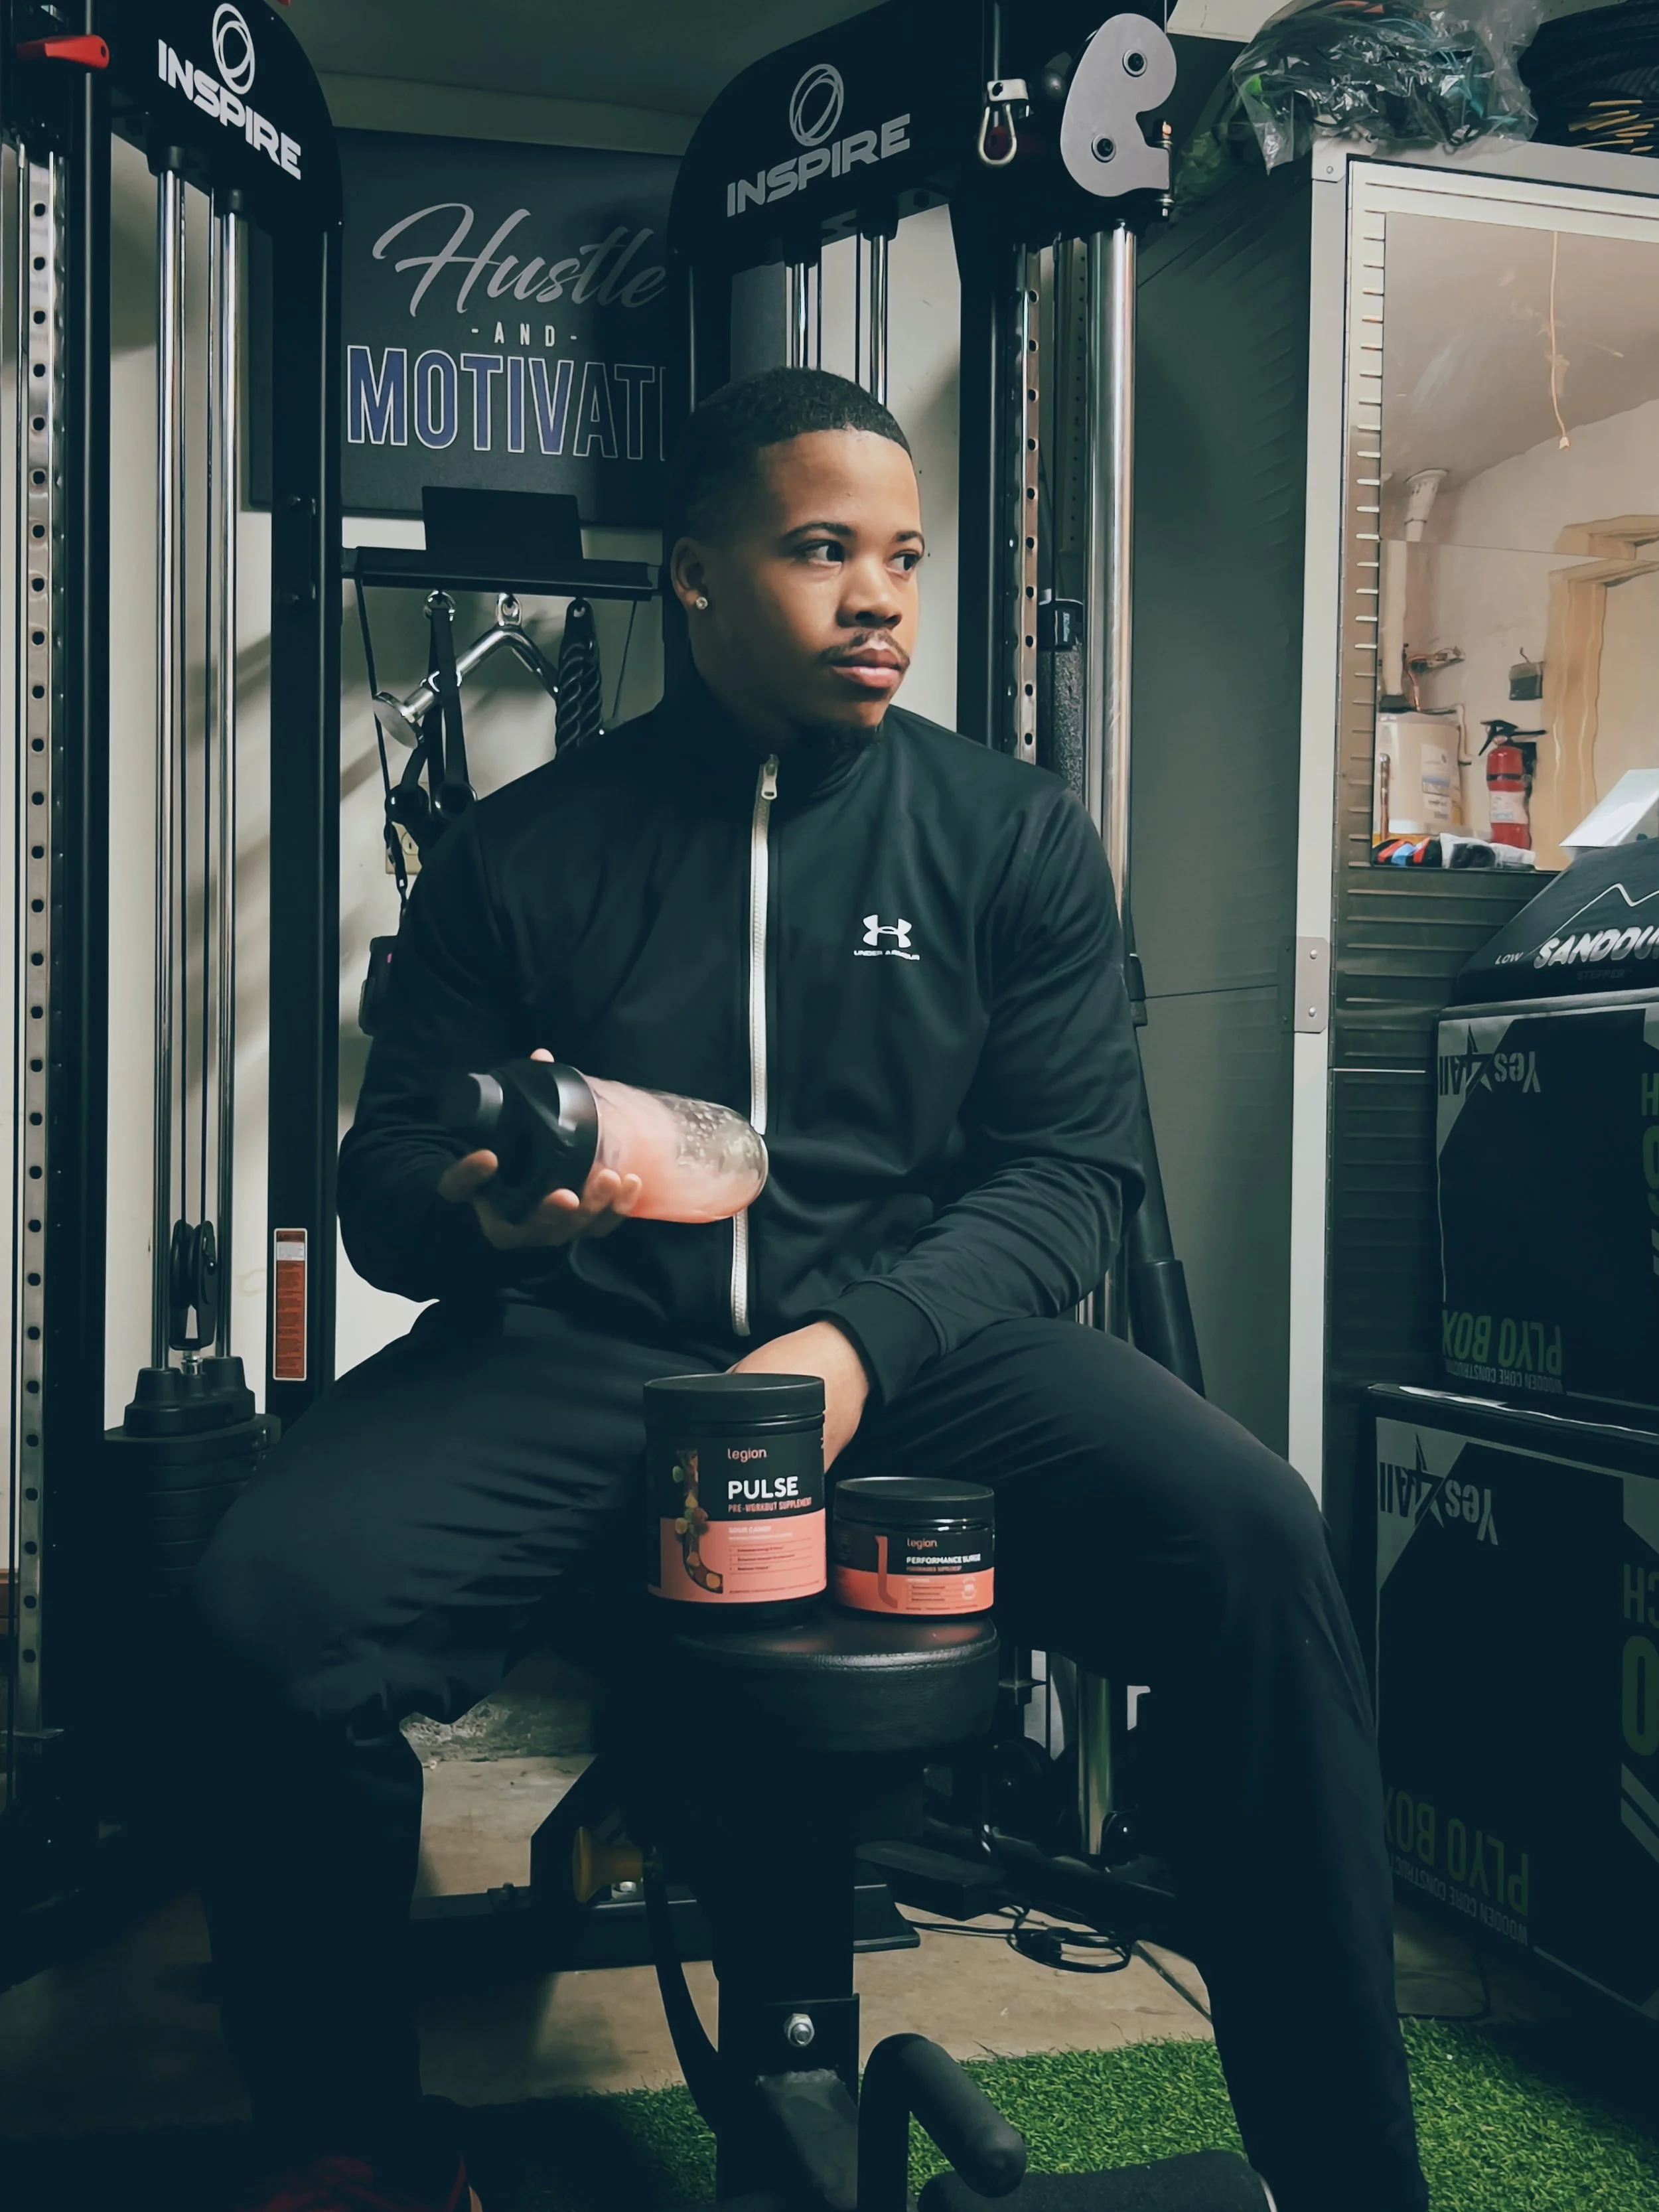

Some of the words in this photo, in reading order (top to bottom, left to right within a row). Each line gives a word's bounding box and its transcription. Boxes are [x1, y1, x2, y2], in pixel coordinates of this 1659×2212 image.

[157, 38, 302, 181] INSPIRE
[727, 113, 910, 218] INSPIRE
[372, 202, 667, 318] Hustle
[346, 344, 666, 463] MOTIVAT
[1494, 951, 1524, 966] LOW
[1441, 1309, 1492, 1363] BOX
[1498, 1317, 1562, 1376] PLYO
[1498, 1368, 1522, 1388] CORE
[1524, 1373, 1564, 1395] WOODEN
[727, 1448, 767, 1463] legion
[728, 1476, 798, 1500] PULSE
[727, 1501, 778, 1513] PRE-WORKOUT
[906, 1538, 938, 1550] legion
[906, 1556, 962, 1564] PERFORMANCE
[1447, 1817, 1529, 1917] PLYO
[1449, 1885, 1477, 1917] CORE
[1479, 1902, 1528, 1947] WOODEN
